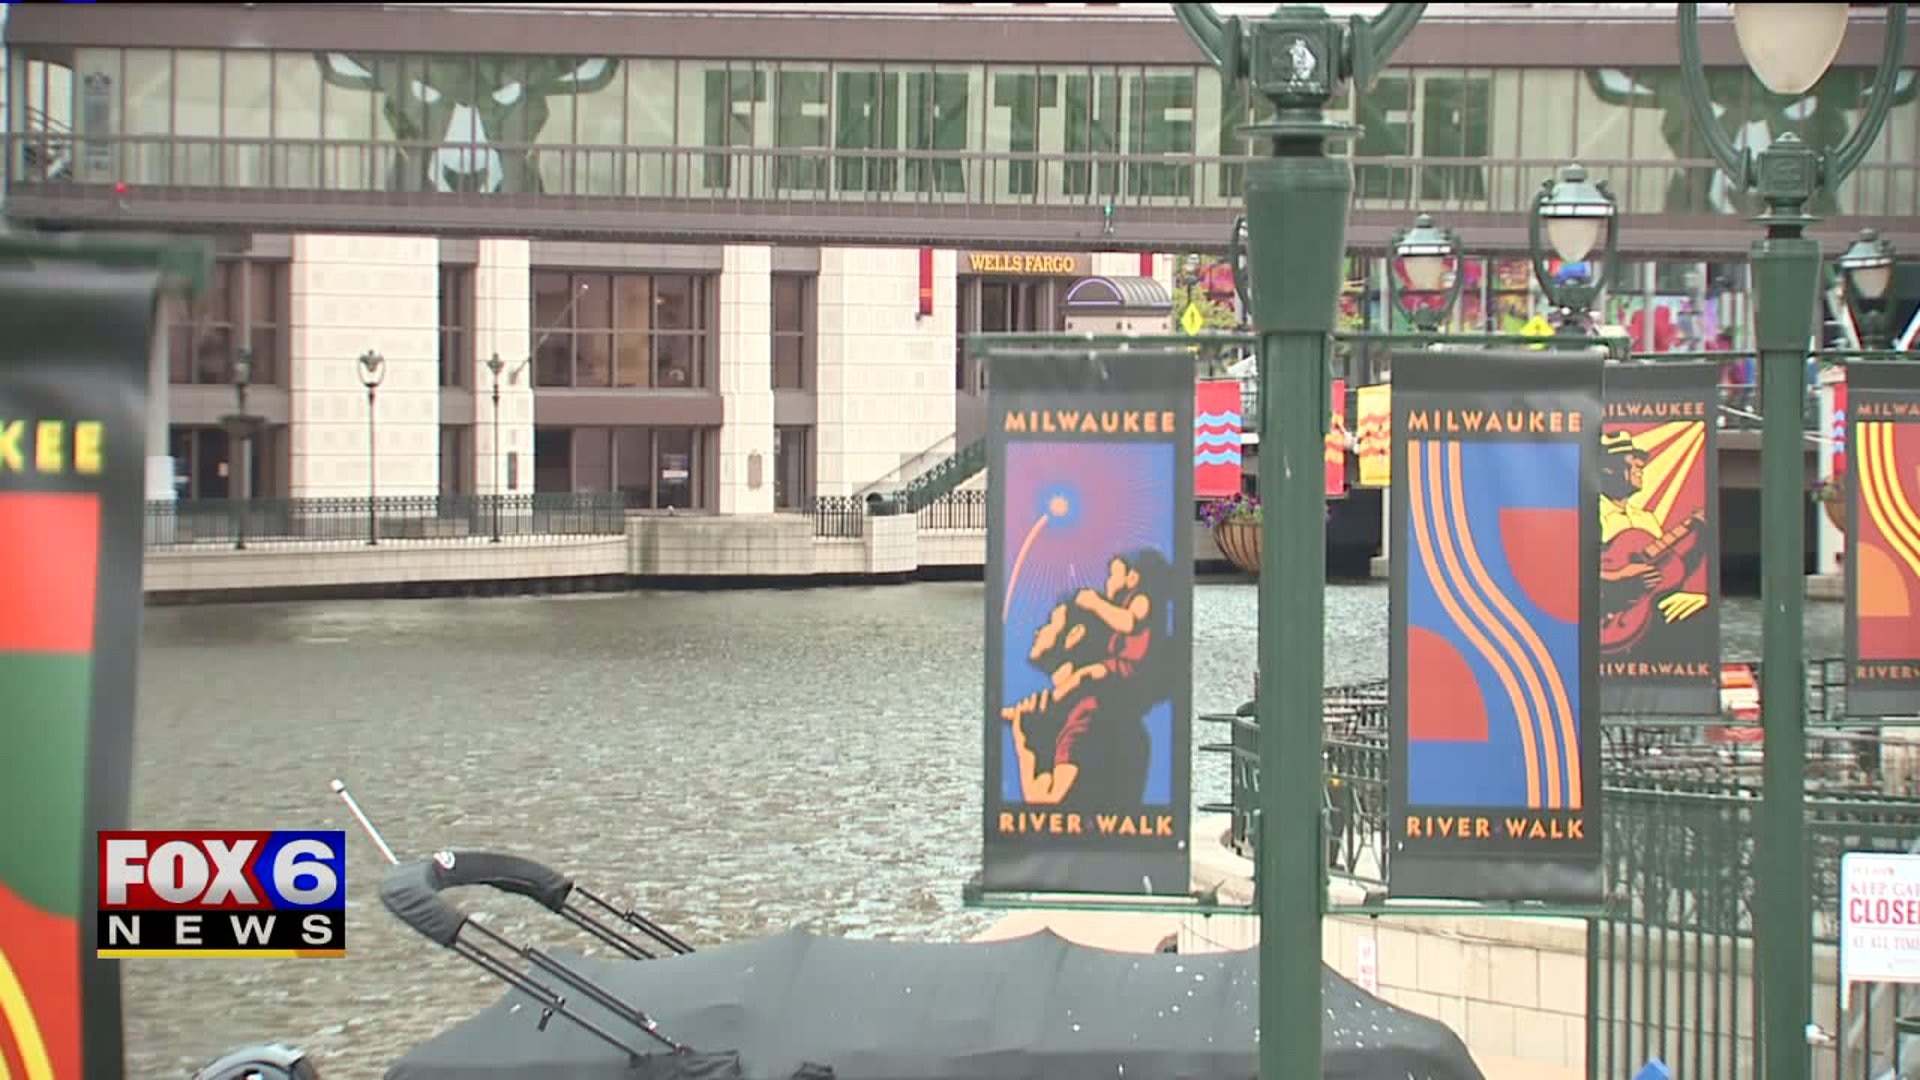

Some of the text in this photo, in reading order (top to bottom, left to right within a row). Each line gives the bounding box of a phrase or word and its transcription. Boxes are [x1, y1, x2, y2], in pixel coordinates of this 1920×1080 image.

[994, 74, 1194, 196] THE
[970, 253, 1075, 273] WELLS FARGO
[1004, 410, 1176, 433] MILWAUKEE
[1407, 410, 1583, 433] MILWAUKEE
[1659, 662, 1712, 676] WALK
[1856, 665, 1912, 679] RIVER
[998, 812, 1173, 836] RIVER WALK
[1406, 815, 1584, 840] RIVER WALK
